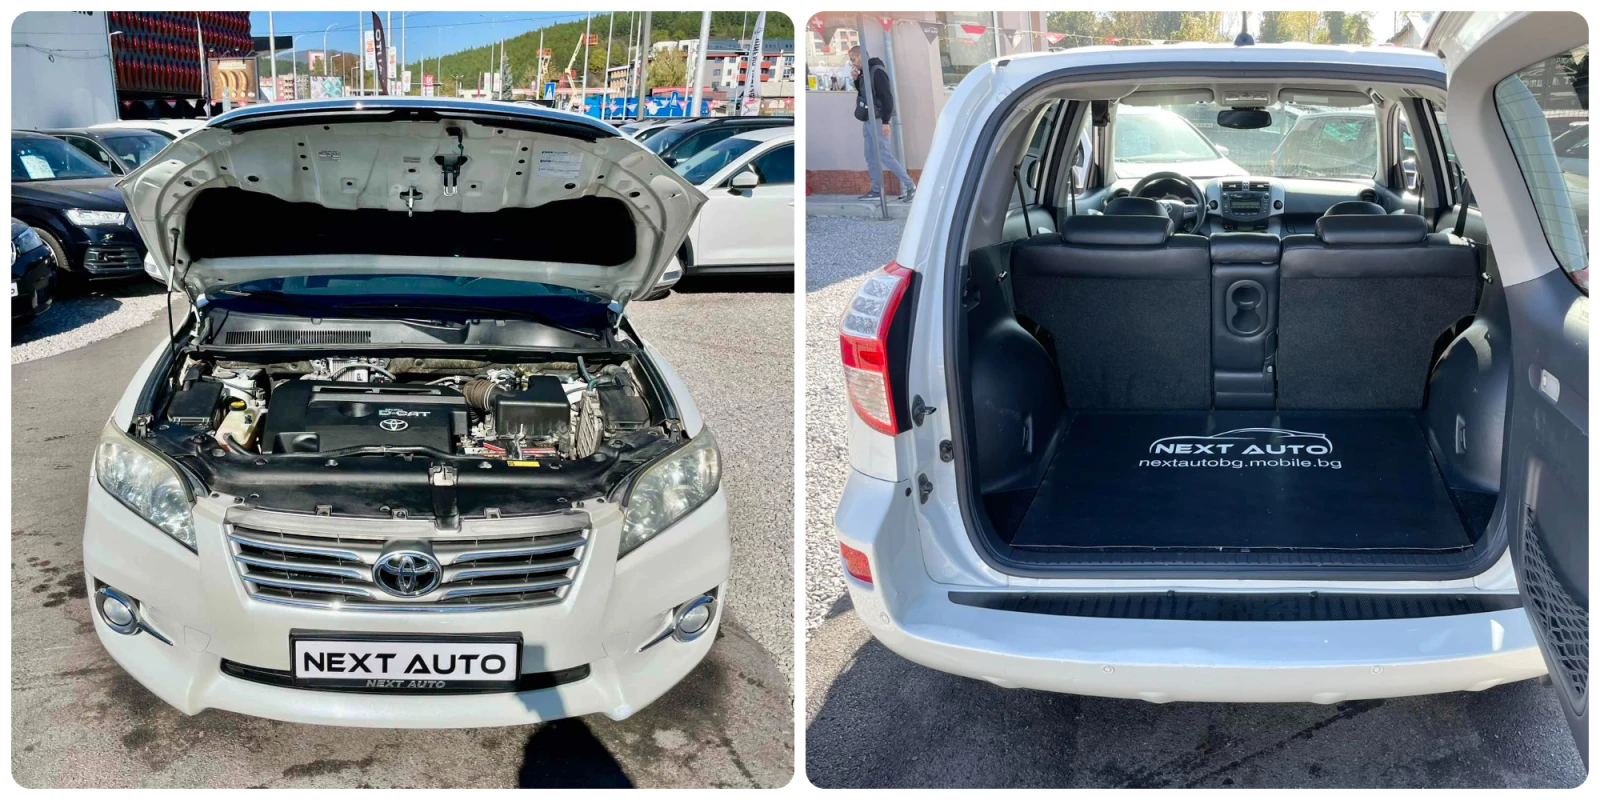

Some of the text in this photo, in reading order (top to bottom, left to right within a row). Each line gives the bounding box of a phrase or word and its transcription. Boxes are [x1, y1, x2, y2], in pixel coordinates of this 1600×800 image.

[1155, 443, 1328, 455] NEXT AUTO
[1138, 457, 1342, 469] nextautobg.mobile.bg
[304, 652, 506, 675] NEXT AUTO
[366, 679, 446, 689] NEXT AUTO
